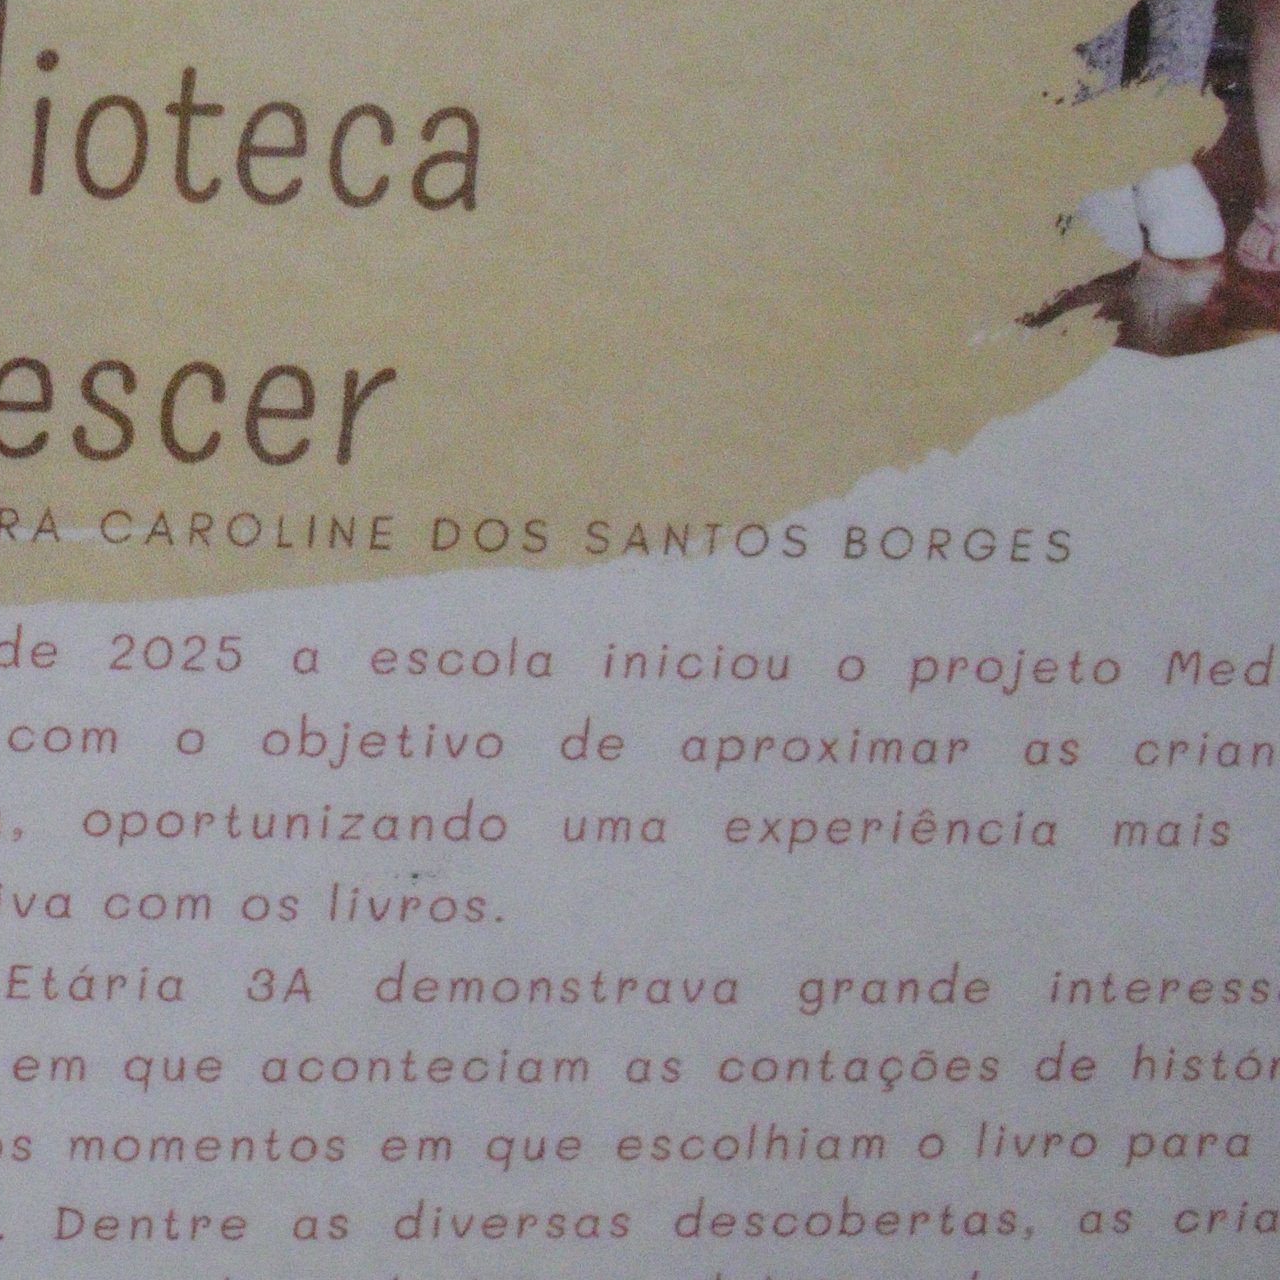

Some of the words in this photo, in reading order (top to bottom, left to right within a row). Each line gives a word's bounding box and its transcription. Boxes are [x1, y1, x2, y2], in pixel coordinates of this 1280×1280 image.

[99, 507, 393, 553] CAROLINE
[429, 515, 548, 555] DOS
[584, 518, 809, 559] SANTOS
[842, 524, 1072, 565] BORGES
[108, 632, 244, 674] 2025
[291, 646, 320, 677] a
[369, 636, 554, 680] escola
[602, 642, 792, 682] iniciou
[835, 654, 867, 683] o
[908, 648, 1122, 698] projeto
[6, 723, 120, 755] com
[175, 726, 206, 757] o
[260, 712, 505, 771] objetivo
[559, 715, 626, 763] de
[679, 727, 971, 772] aproximar
[1022, 737, 1081, 768] as
[80, 797, 508, 848] oportunizando
[562, 815, 667, 844] uma
[723, 807, 1058, 855] experiência
[1112, 812, 1231, 849] mais
[102, 892, 213, 922] com
[239, 893, 300, 923] os
[328, 880, 504, 924] livros.
[4, 962, 184, 1004] Etária
[245, 966, 313, 1004] 3A
[374, 959, 740, 1006] demonstrava
[797, 961, 992, 1017] grande
[1048, 970, 1280, 1006] interess
[10, 1053, 88, 1084] em
[122, 1054, 224, 1093] que
[260, 1048, 590, 1085] aconteciam
[625, 1056, 682, 1085] as
[716, 1048, 1000, 1094] contações
[1034, 1039, 1098, 1084] de
[68, 1128, 346, 1164] momentos
[379, 1134, 454, 1164] em
[484, 1134, 583, 1173] que
[615, 1122, 887, 1163] escolhiam
[917, 1131, 946, 1161] o
[975, 1120, 1099, 1160] livro
[1124, 1131, 1252, 1168] para
[52, 1204, 249, 1243] Dentre
[291, 1212, 350, 1242] as
[393, 1198, 630, 1242] diversas
[673, 1195, 1034, 1240] descobertas,
[1077, 1207, 1134, 1236] as
